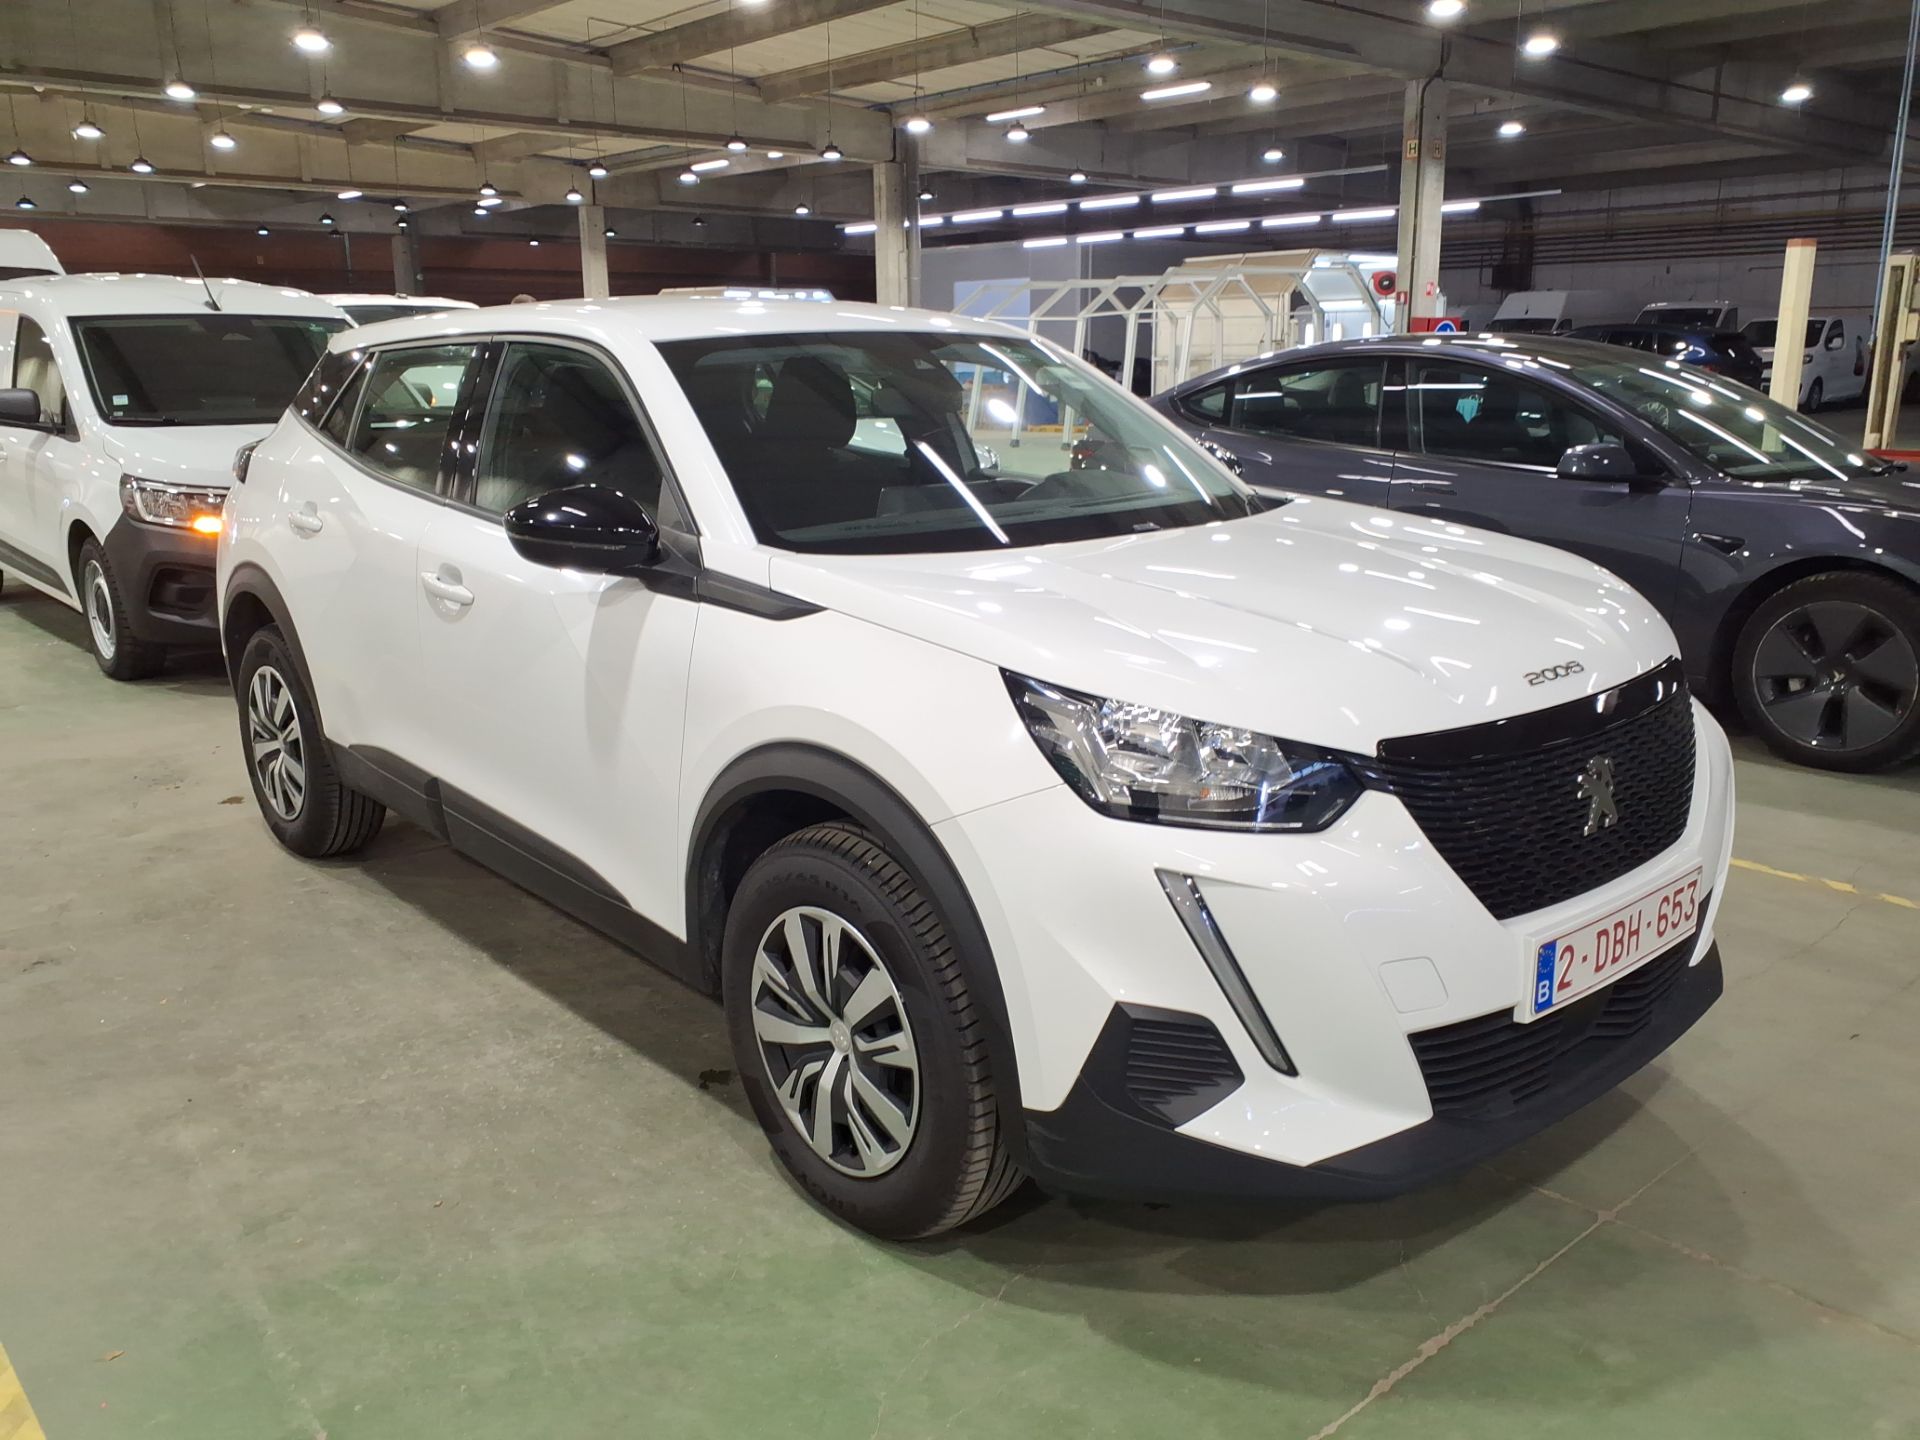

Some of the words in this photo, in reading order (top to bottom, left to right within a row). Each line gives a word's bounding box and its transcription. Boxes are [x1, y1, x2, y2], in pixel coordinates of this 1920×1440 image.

[1408, 142, 1417, 156] H
[1523, 660, 1585, 686] 2008
[1537, 980, 1550, 1004] B
